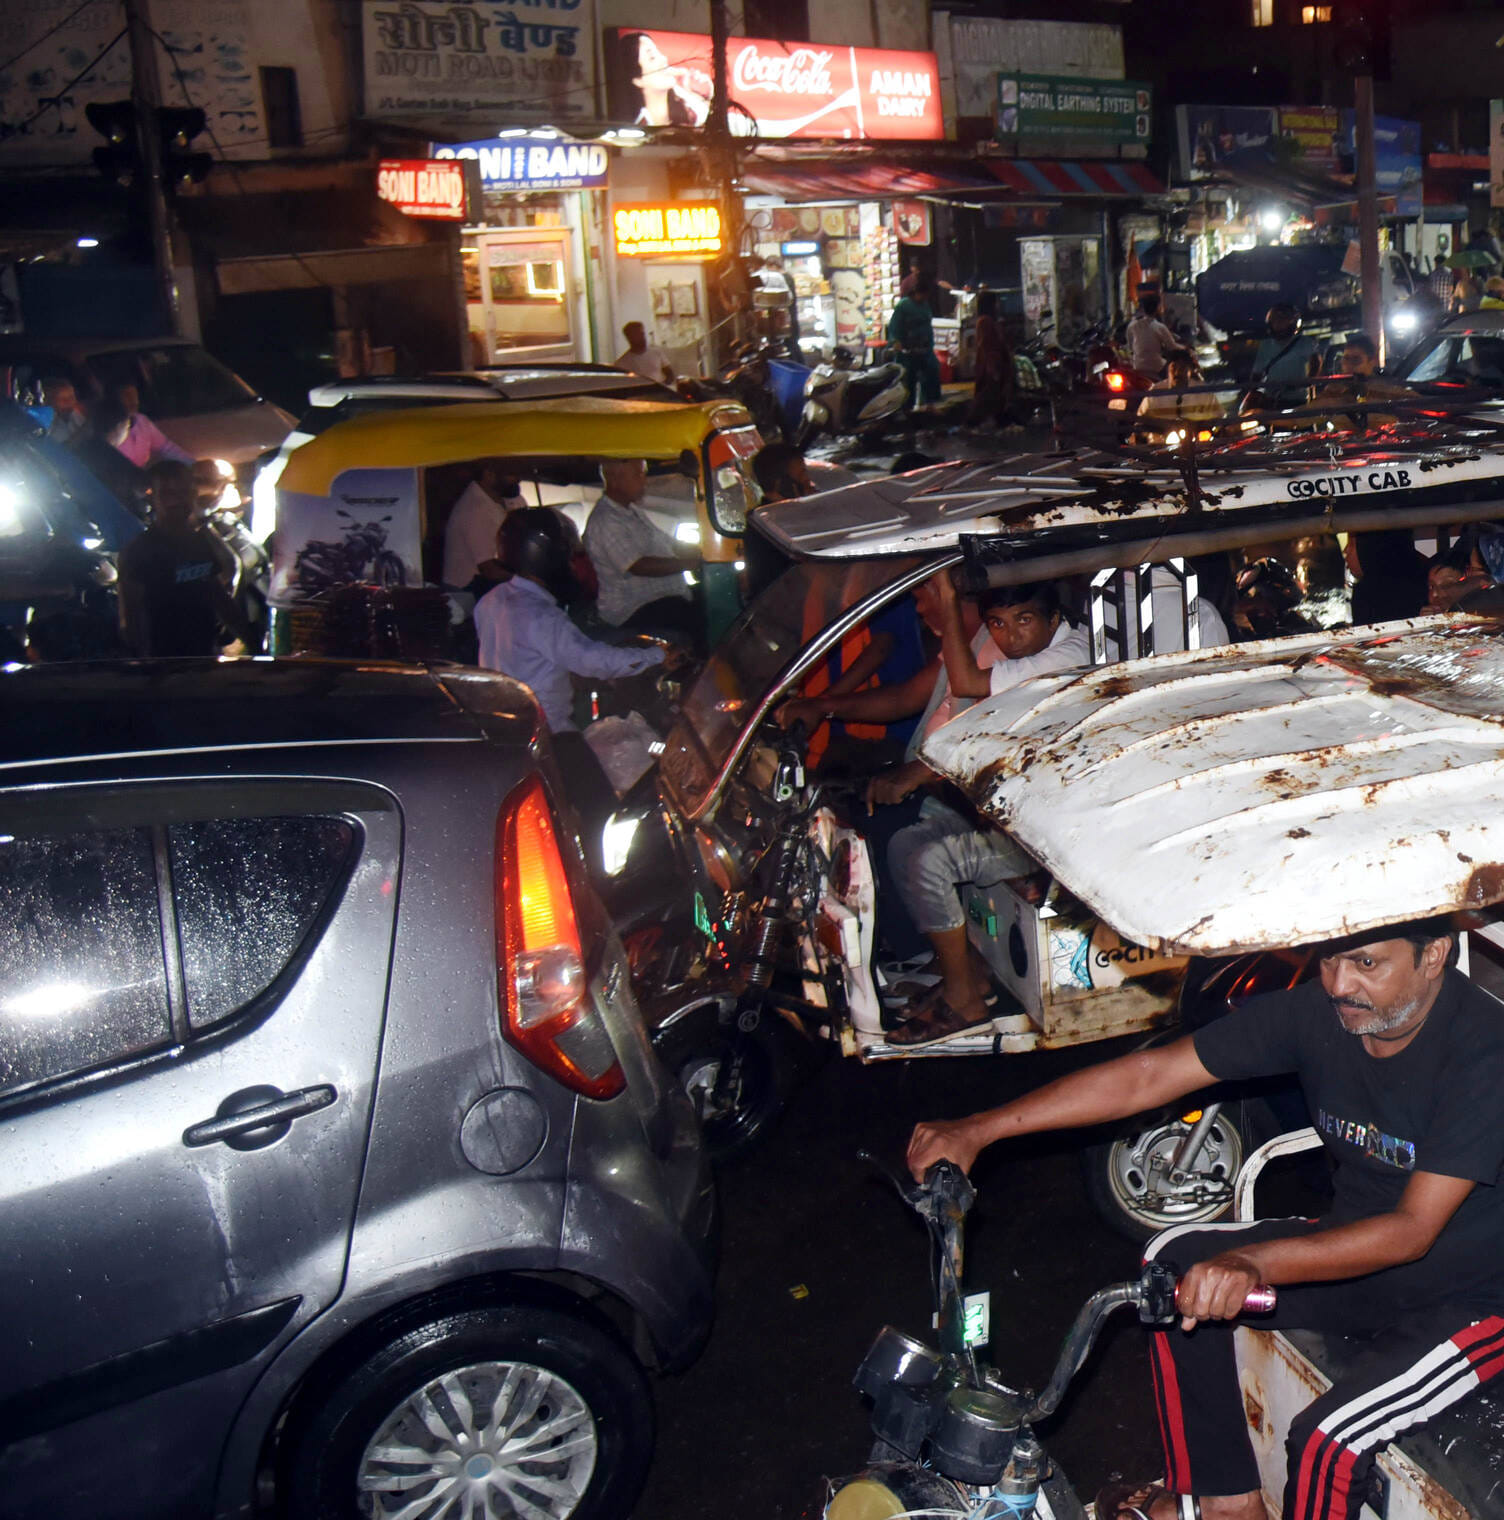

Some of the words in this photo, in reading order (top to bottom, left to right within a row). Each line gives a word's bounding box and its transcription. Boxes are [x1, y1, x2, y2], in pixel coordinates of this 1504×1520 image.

[869, 70, 931, 96] AMAN
[878, 97, 926, 116] DAIRY
[1020, 92, 1055, 110] DIGITAL
[1057, 94, 1101, 112] EARTHING
[1103, 97, 1136, 114] SYSTEM
[528, 146, 608, 178] BAND
[378, 170, 415, 202] SONI
[417, 171, 463, 205] BAND
[614, 209, 663, 241] SONI
[666, 206, 720, 239] BAND
[1368, 470, 1411, 490] CAB
